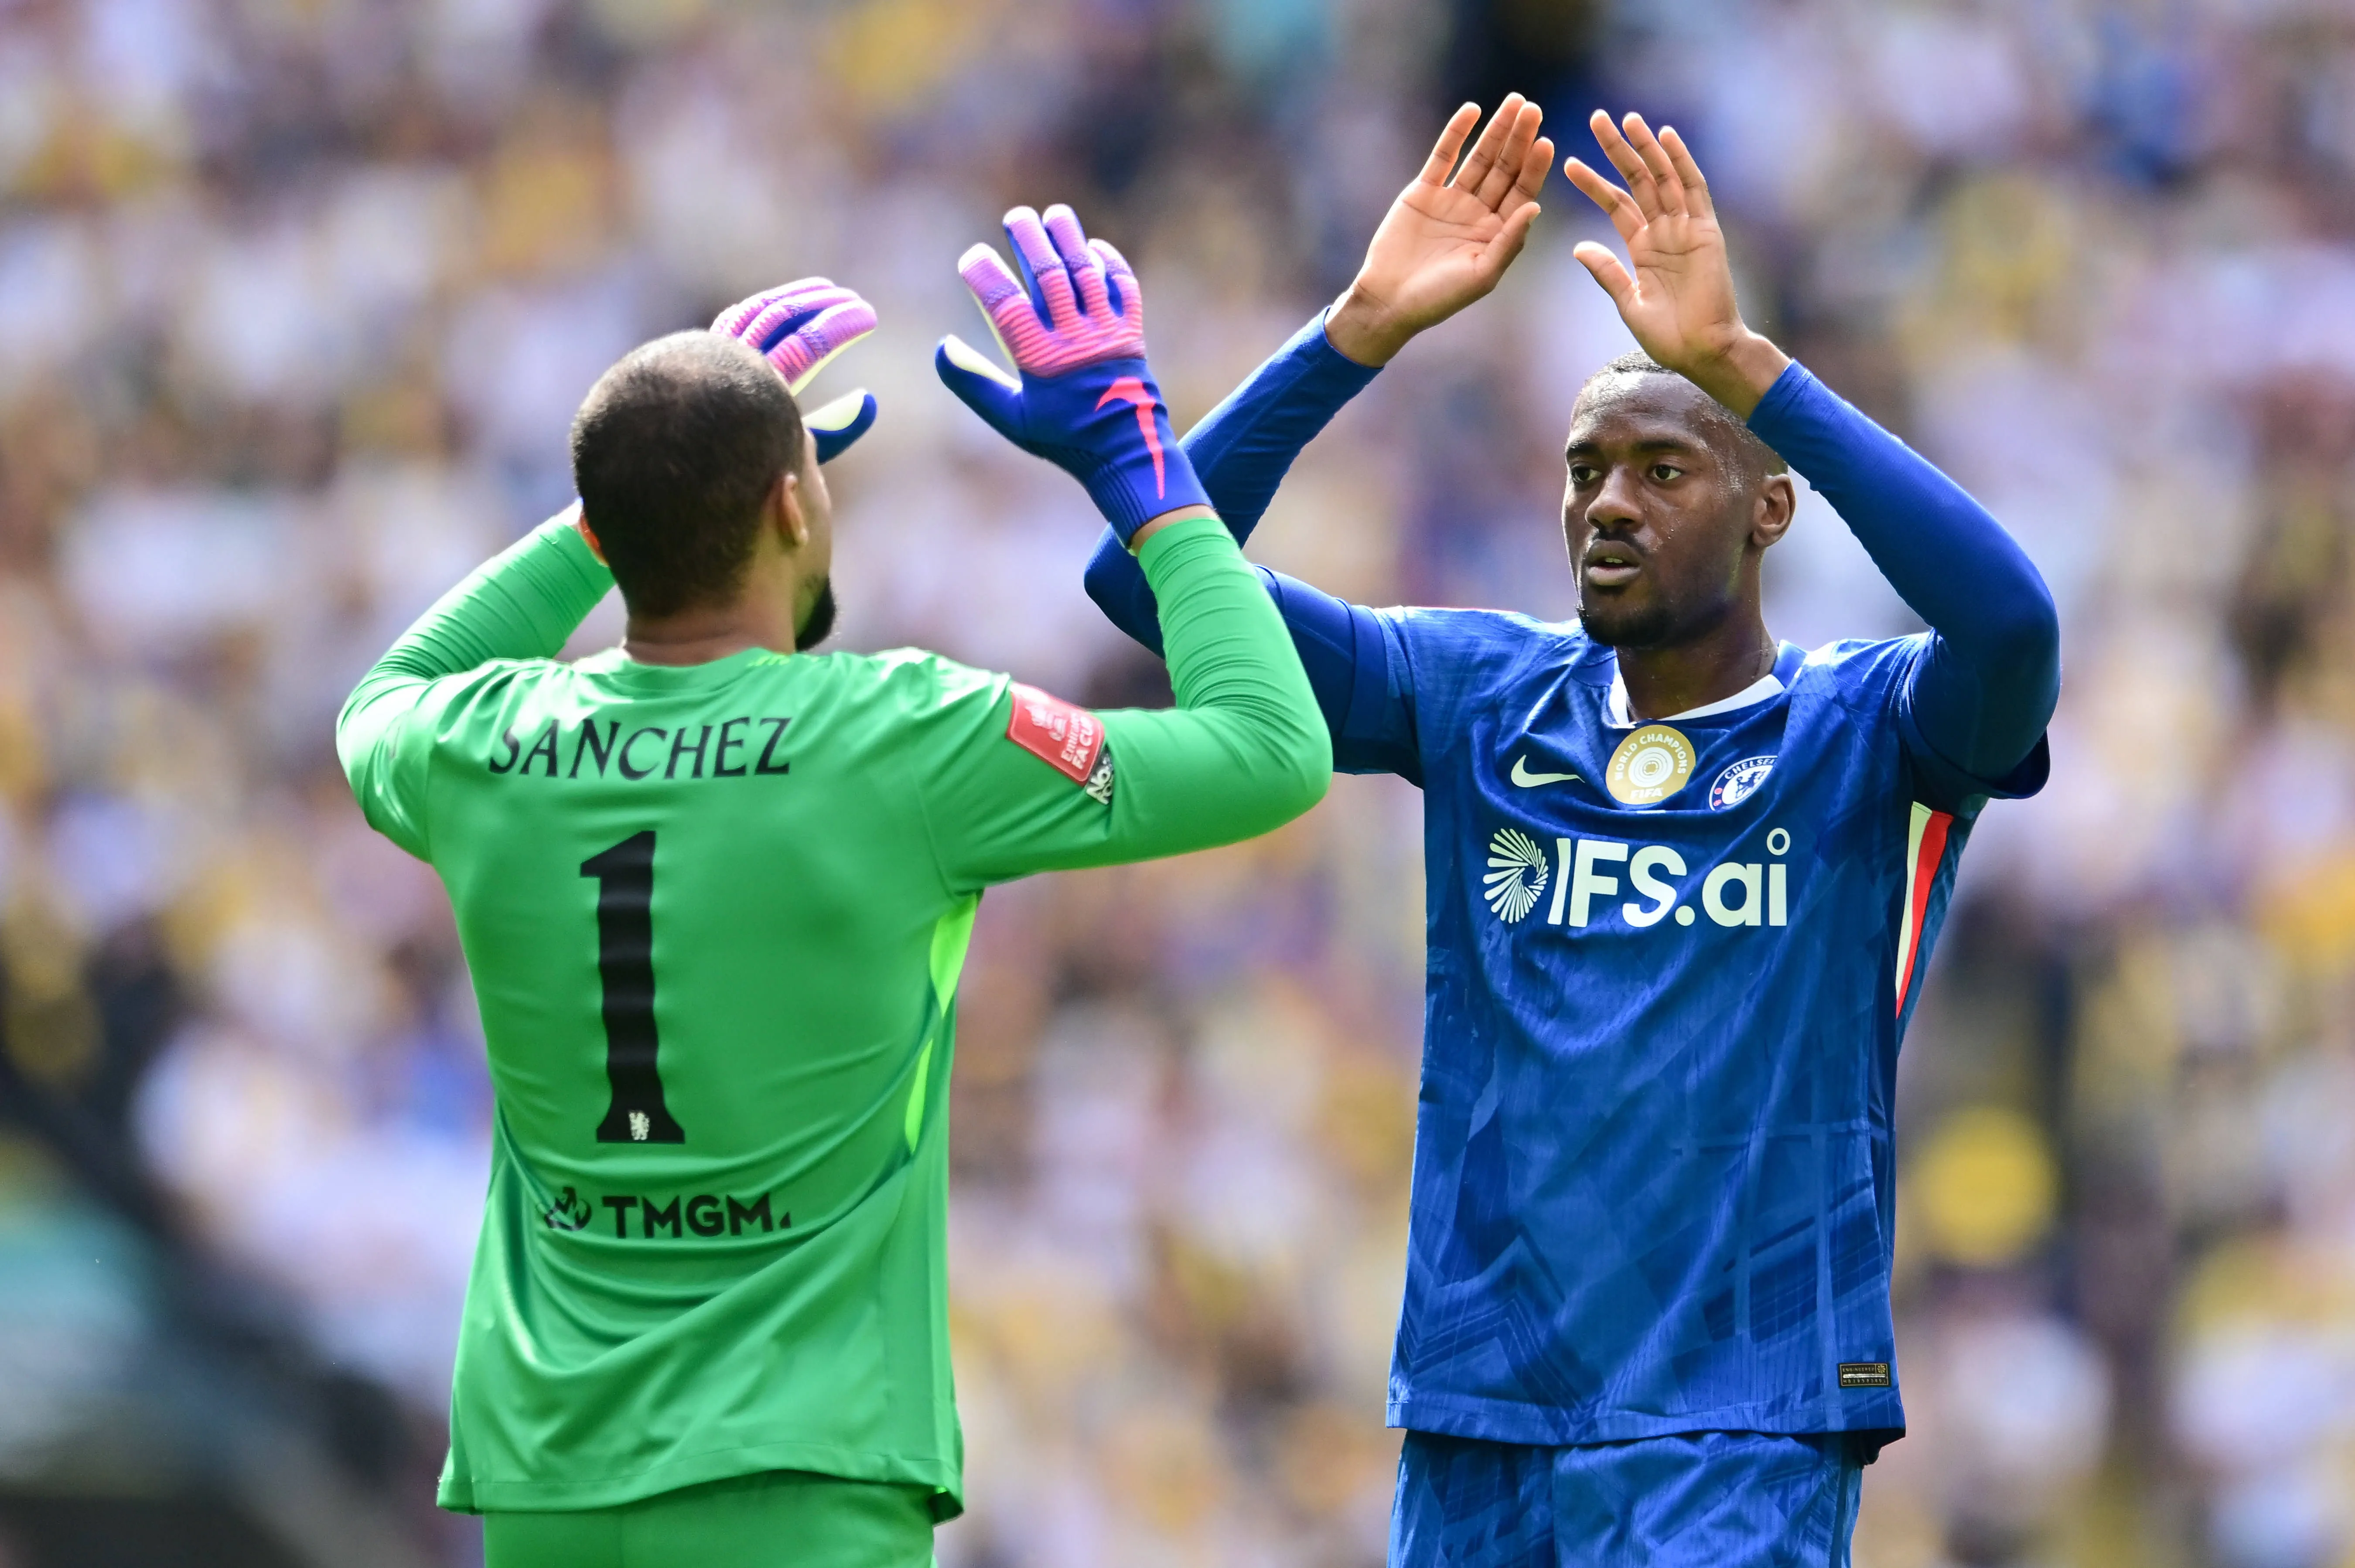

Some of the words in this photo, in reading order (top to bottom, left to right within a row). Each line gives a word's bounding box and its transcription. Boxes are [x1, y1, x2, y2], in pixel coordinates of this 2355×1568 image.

[488, 716, 792, 781] SANCHEZ
[1072, 749, 1089, 770] FA
[1614, 743, 1638, 781] WORLD
[1639, 733, 1687, 774] CHAMPIONS
[1630, 787, 1663, 799] FIFA
[1547, 827, 1791, 927] IFS.ai
[580, 831, 685, 1144] 1
[602, 1192, 774, 1239] TMGM
